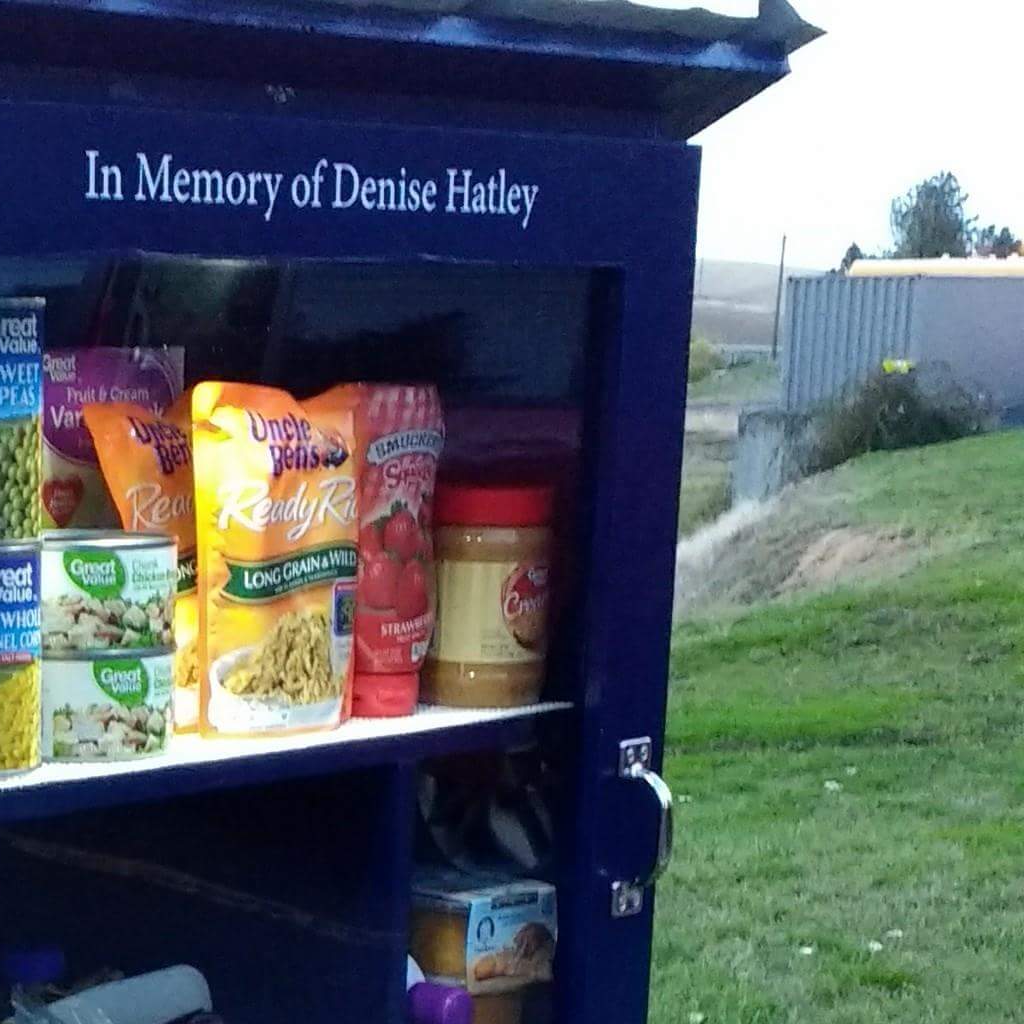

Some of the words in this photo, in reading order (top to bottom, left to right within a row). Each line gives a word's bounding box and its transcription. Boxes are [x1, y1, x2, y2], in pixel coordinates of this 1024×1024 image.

[85, 150, 124, 200] In
[135, 153, 282, 221] Memory
[291, 158, 328, 208] of
[332, 162, 436, 211] Denise
[446, 168, 539, 228] Hatley
[66, 385, 96, 403] Fruit
[110, 385, 149, 402] Cream
[245, 410, 312, 442] Uncle
[154, 440, 191, 475] Ben
[269, 444, 321, 477] Ben's
[126, 483, 193, 530] Rea
[217, 479, 320, 541] Ready
[319, 476, 356, 523] Ri
[71, 559, 115, 577] Great
[243, 566, 281, 591] LONG
[282, 556, 321, 581] GRAIN
[328, 549, 357, 569] WILD
[20, 630, 41, 648] COR
[101, 667, 141, 683] Great
